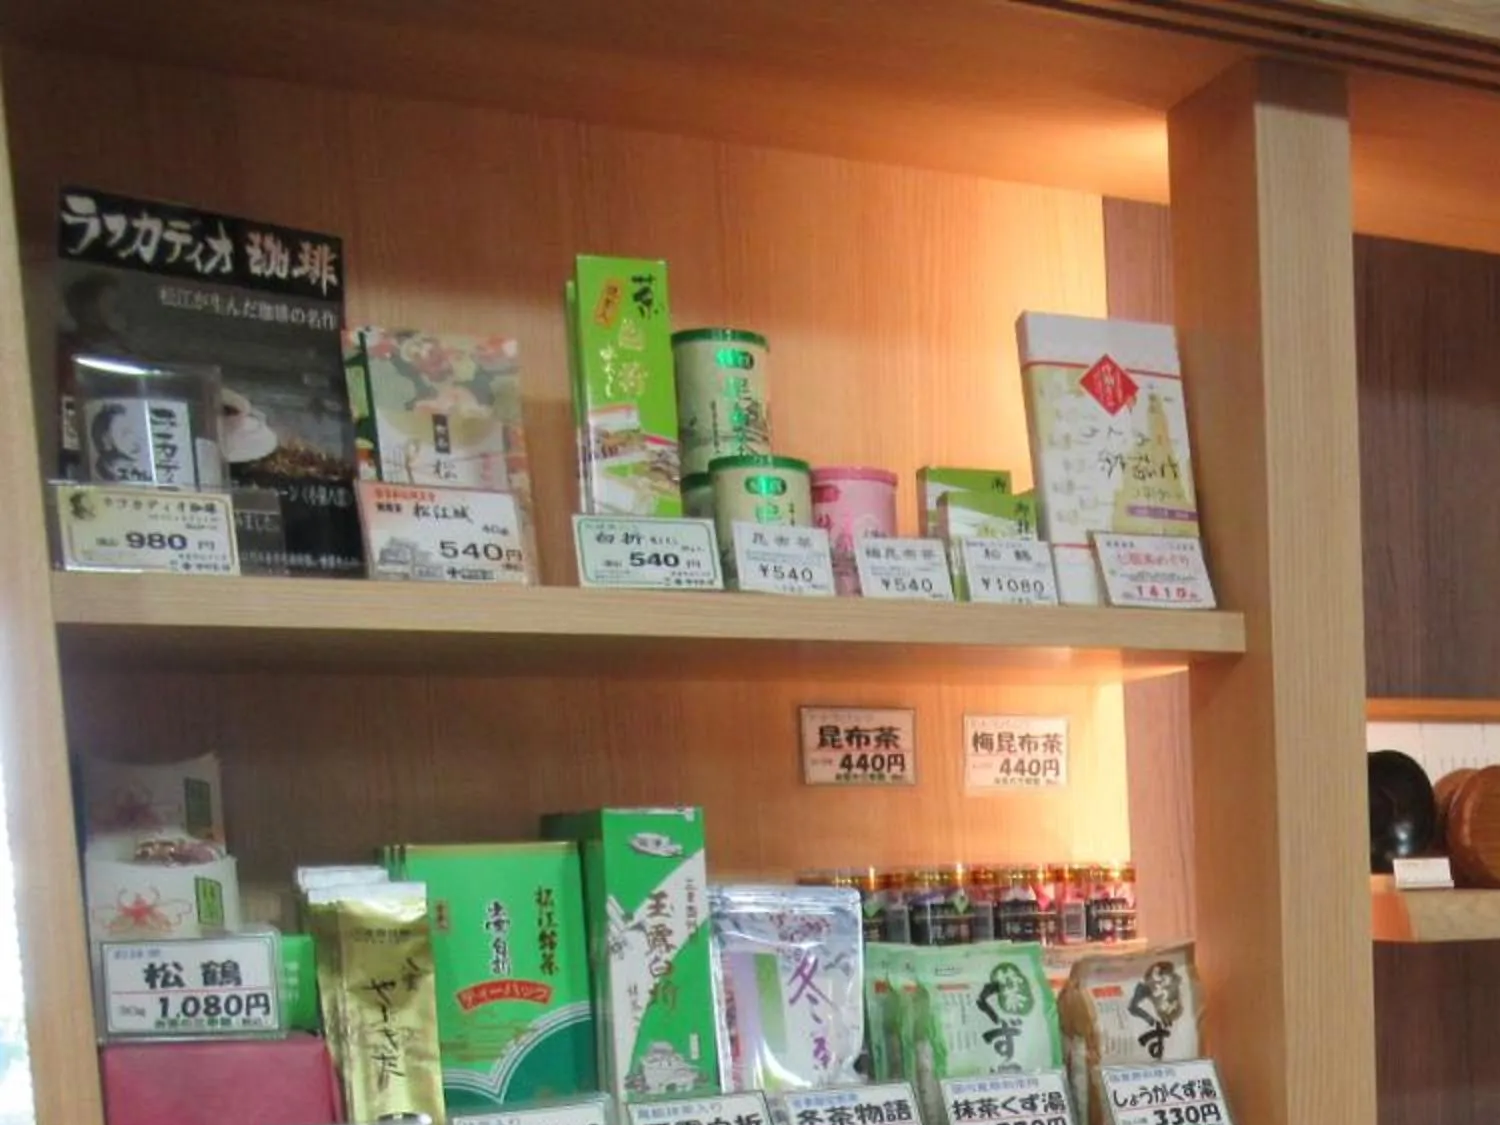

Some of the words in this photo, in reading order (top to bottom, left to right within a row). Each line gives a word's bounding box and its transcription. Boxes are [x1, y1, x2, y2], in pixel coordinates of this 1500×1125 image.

[125, 531, 188, 551] 980
[439, 540, 523, 562] 540円
[629, 551, 681, 568] 540
[759, 564, 814, 582] ¥540
[817, 724, 903, 749] 昆布茶
[971, 730, 1064, 755] 梅昆布茶
[839, 753, 906, 773] 440円
[999, 758, 1061, 778] 440円
[1113, 1077, 1217, 1108] しょうがくず湯
[952, 1091, 1066, 1121] 抹茶くず湯
